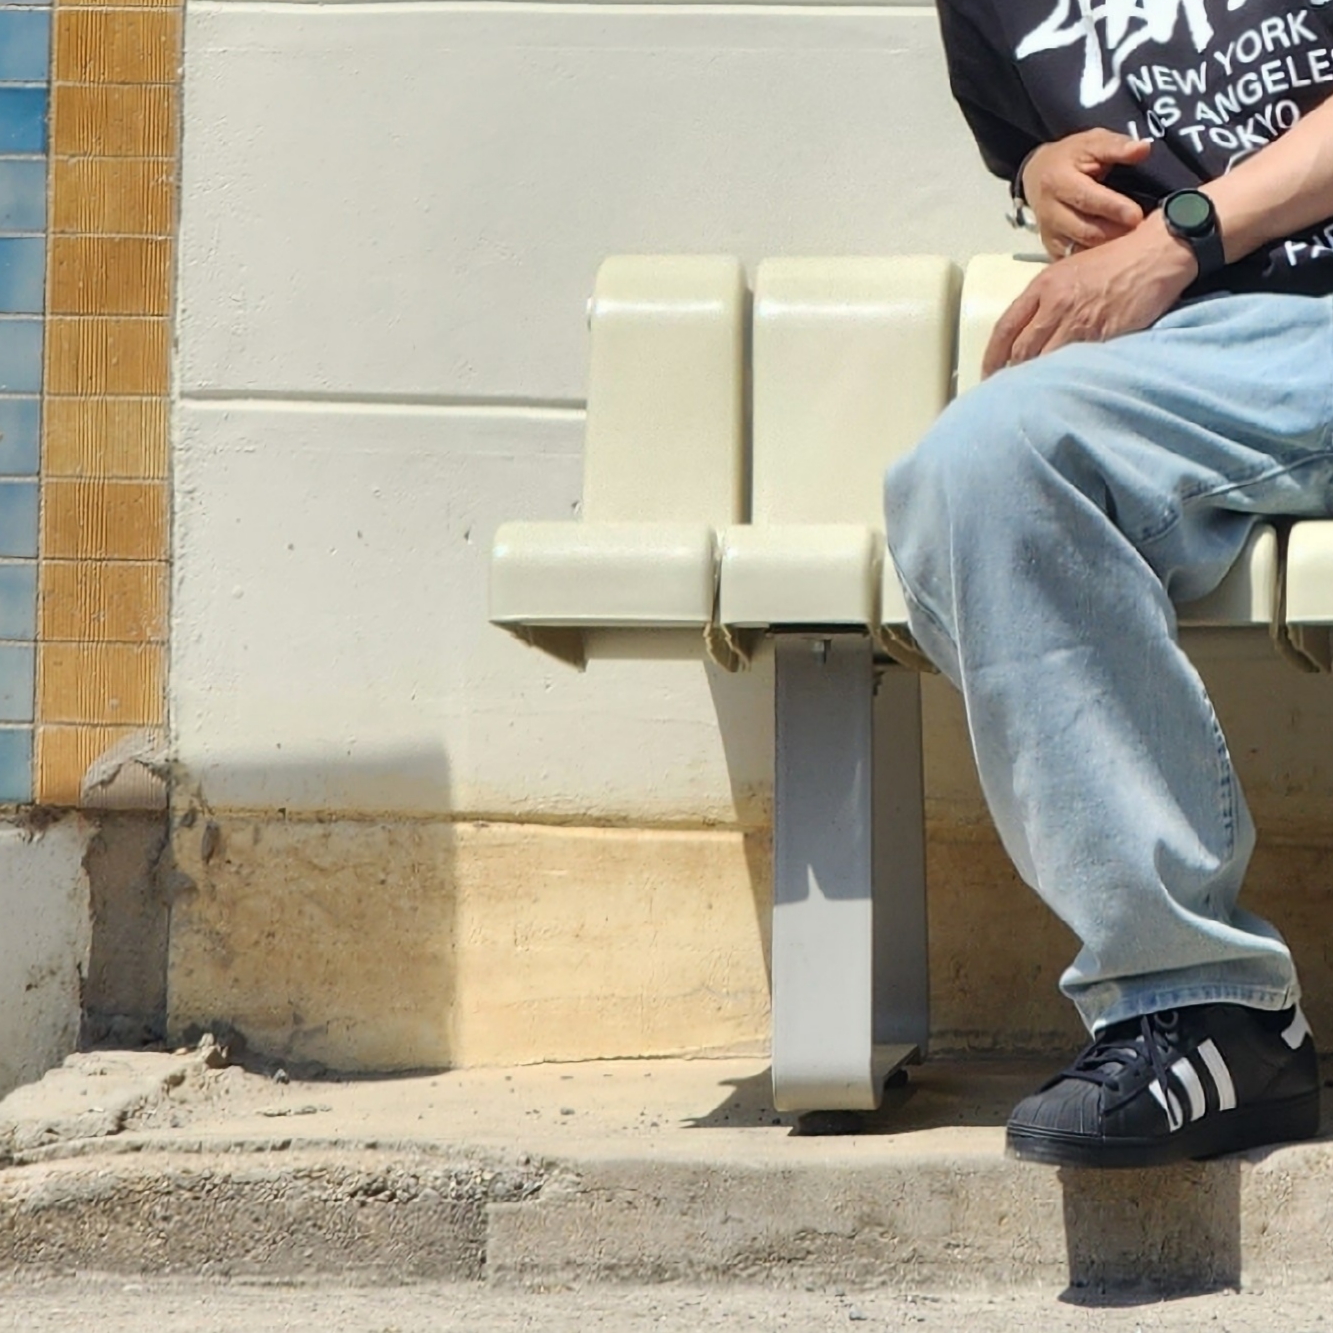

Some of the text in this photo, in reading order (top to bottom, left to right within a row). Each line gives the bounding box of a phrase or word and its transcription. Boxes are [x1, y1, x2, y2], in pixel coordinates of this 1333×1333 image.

[1126, 9, 1318, 102] NEW YORK
[1127, 96, 1183, 144] LOS
[1179, 98, 1301, 153] TOKYO
